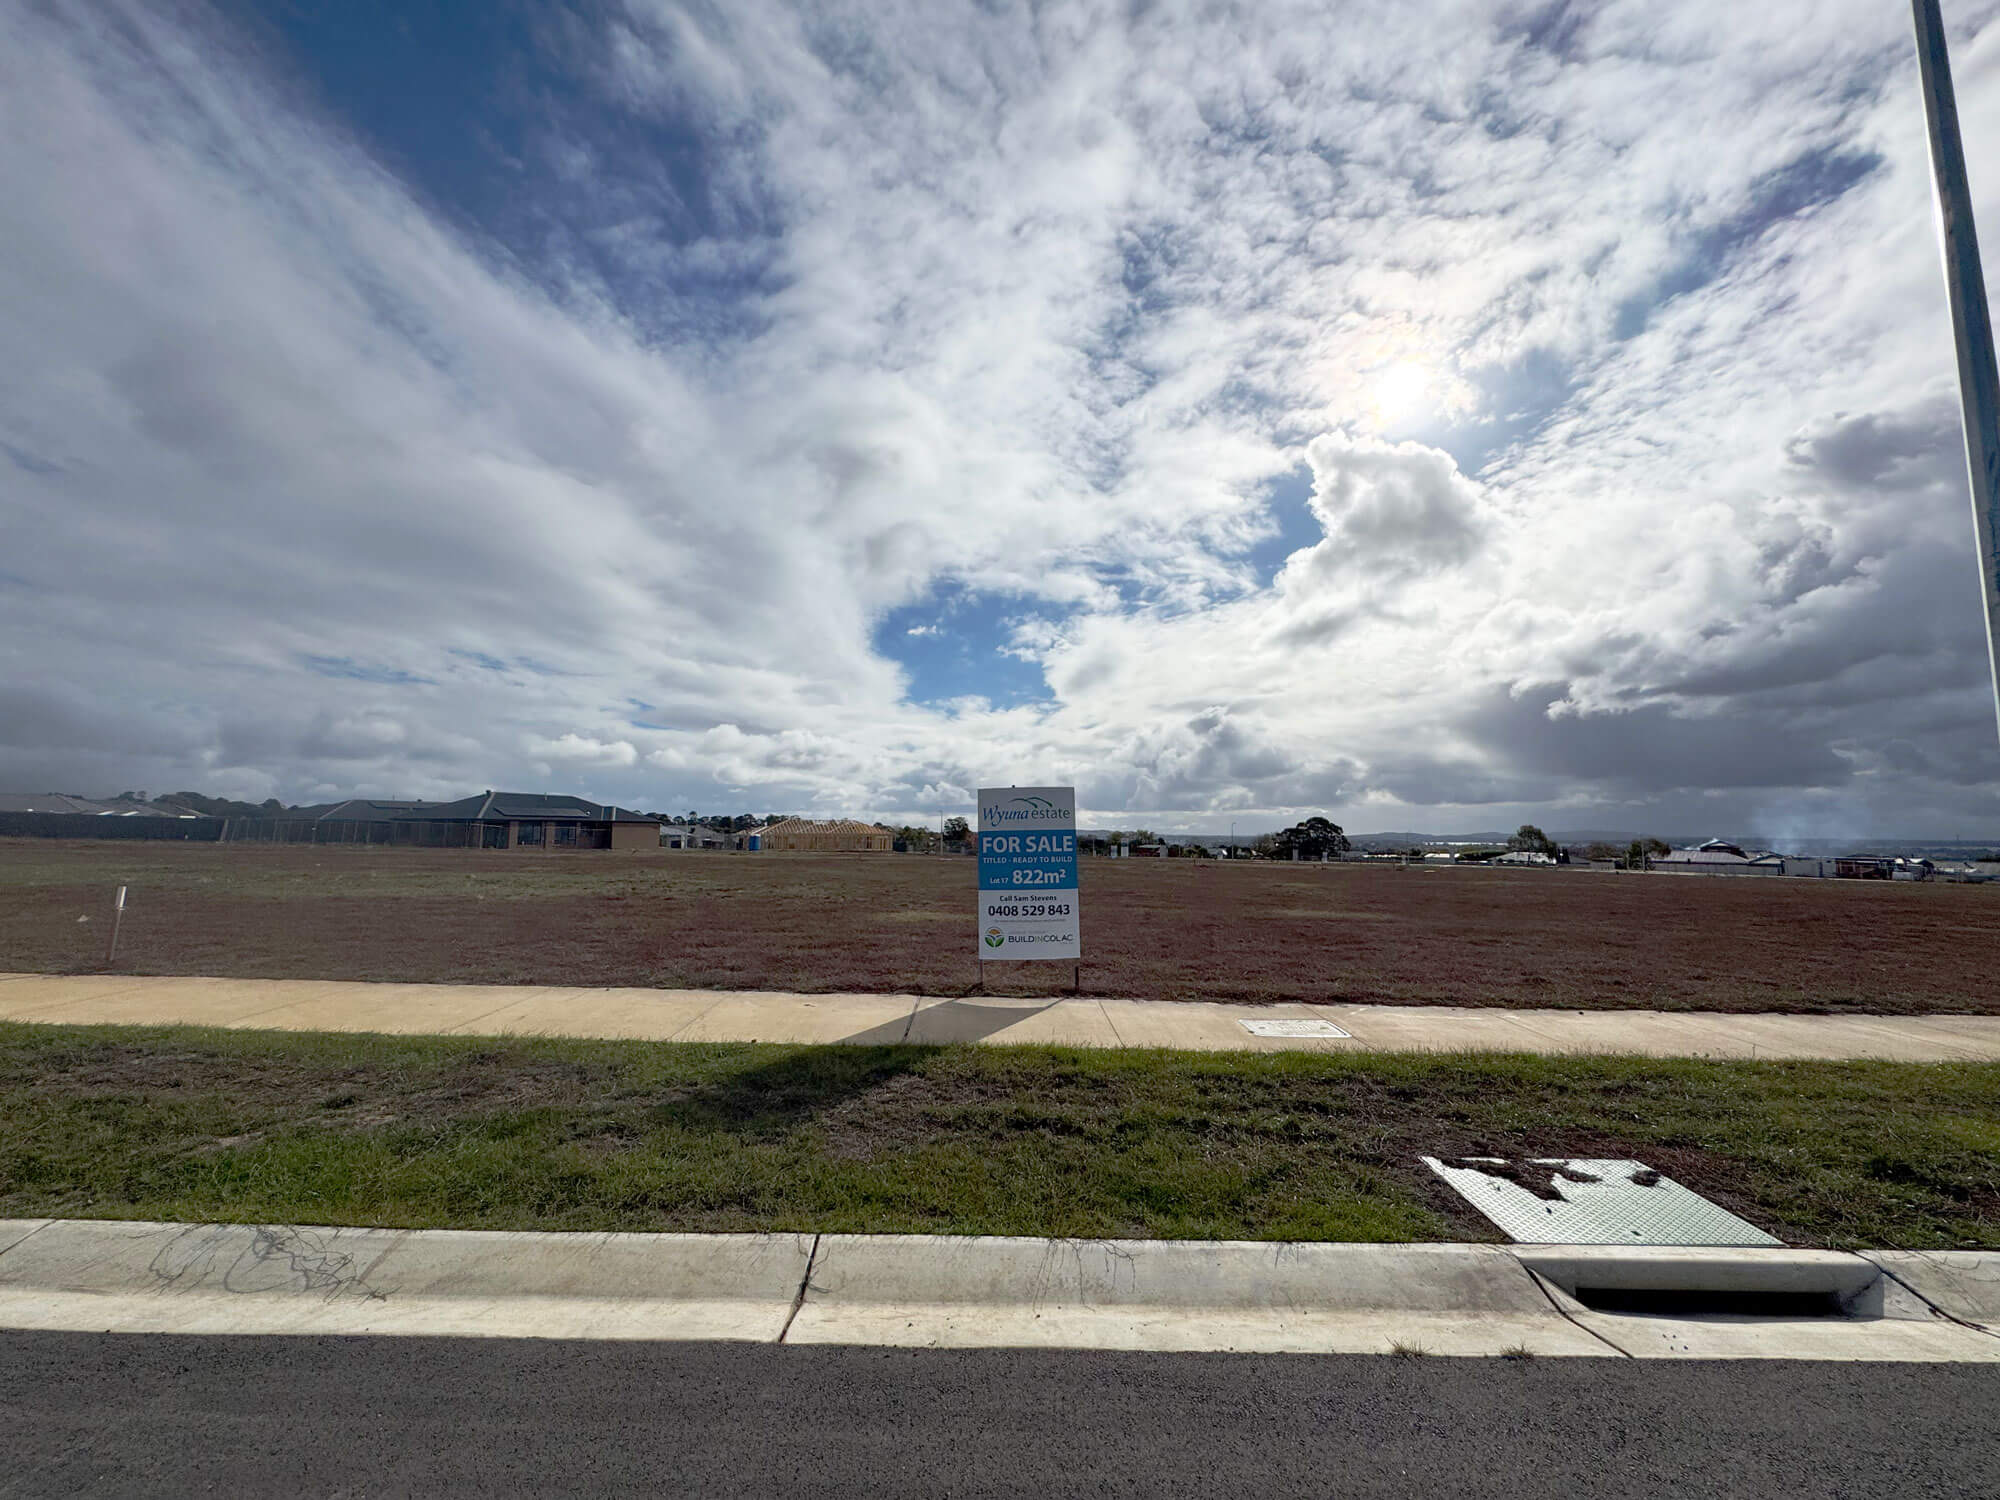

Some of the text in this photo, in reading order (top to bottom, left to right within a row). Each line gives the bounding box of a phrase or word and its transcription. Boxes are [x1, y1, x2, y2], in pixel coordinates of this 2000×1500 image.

[983, 804, 1070, 827] Wyuna estate
[982, 835, 1073, 854] FOR SALE
[1013, 856, 1038, 864] READY
[1051, 855, 1073, 863] BUILD
[1030, 894, 1057, 902] Stevens
[988, 904, 1070, 916] 0408 529 843
